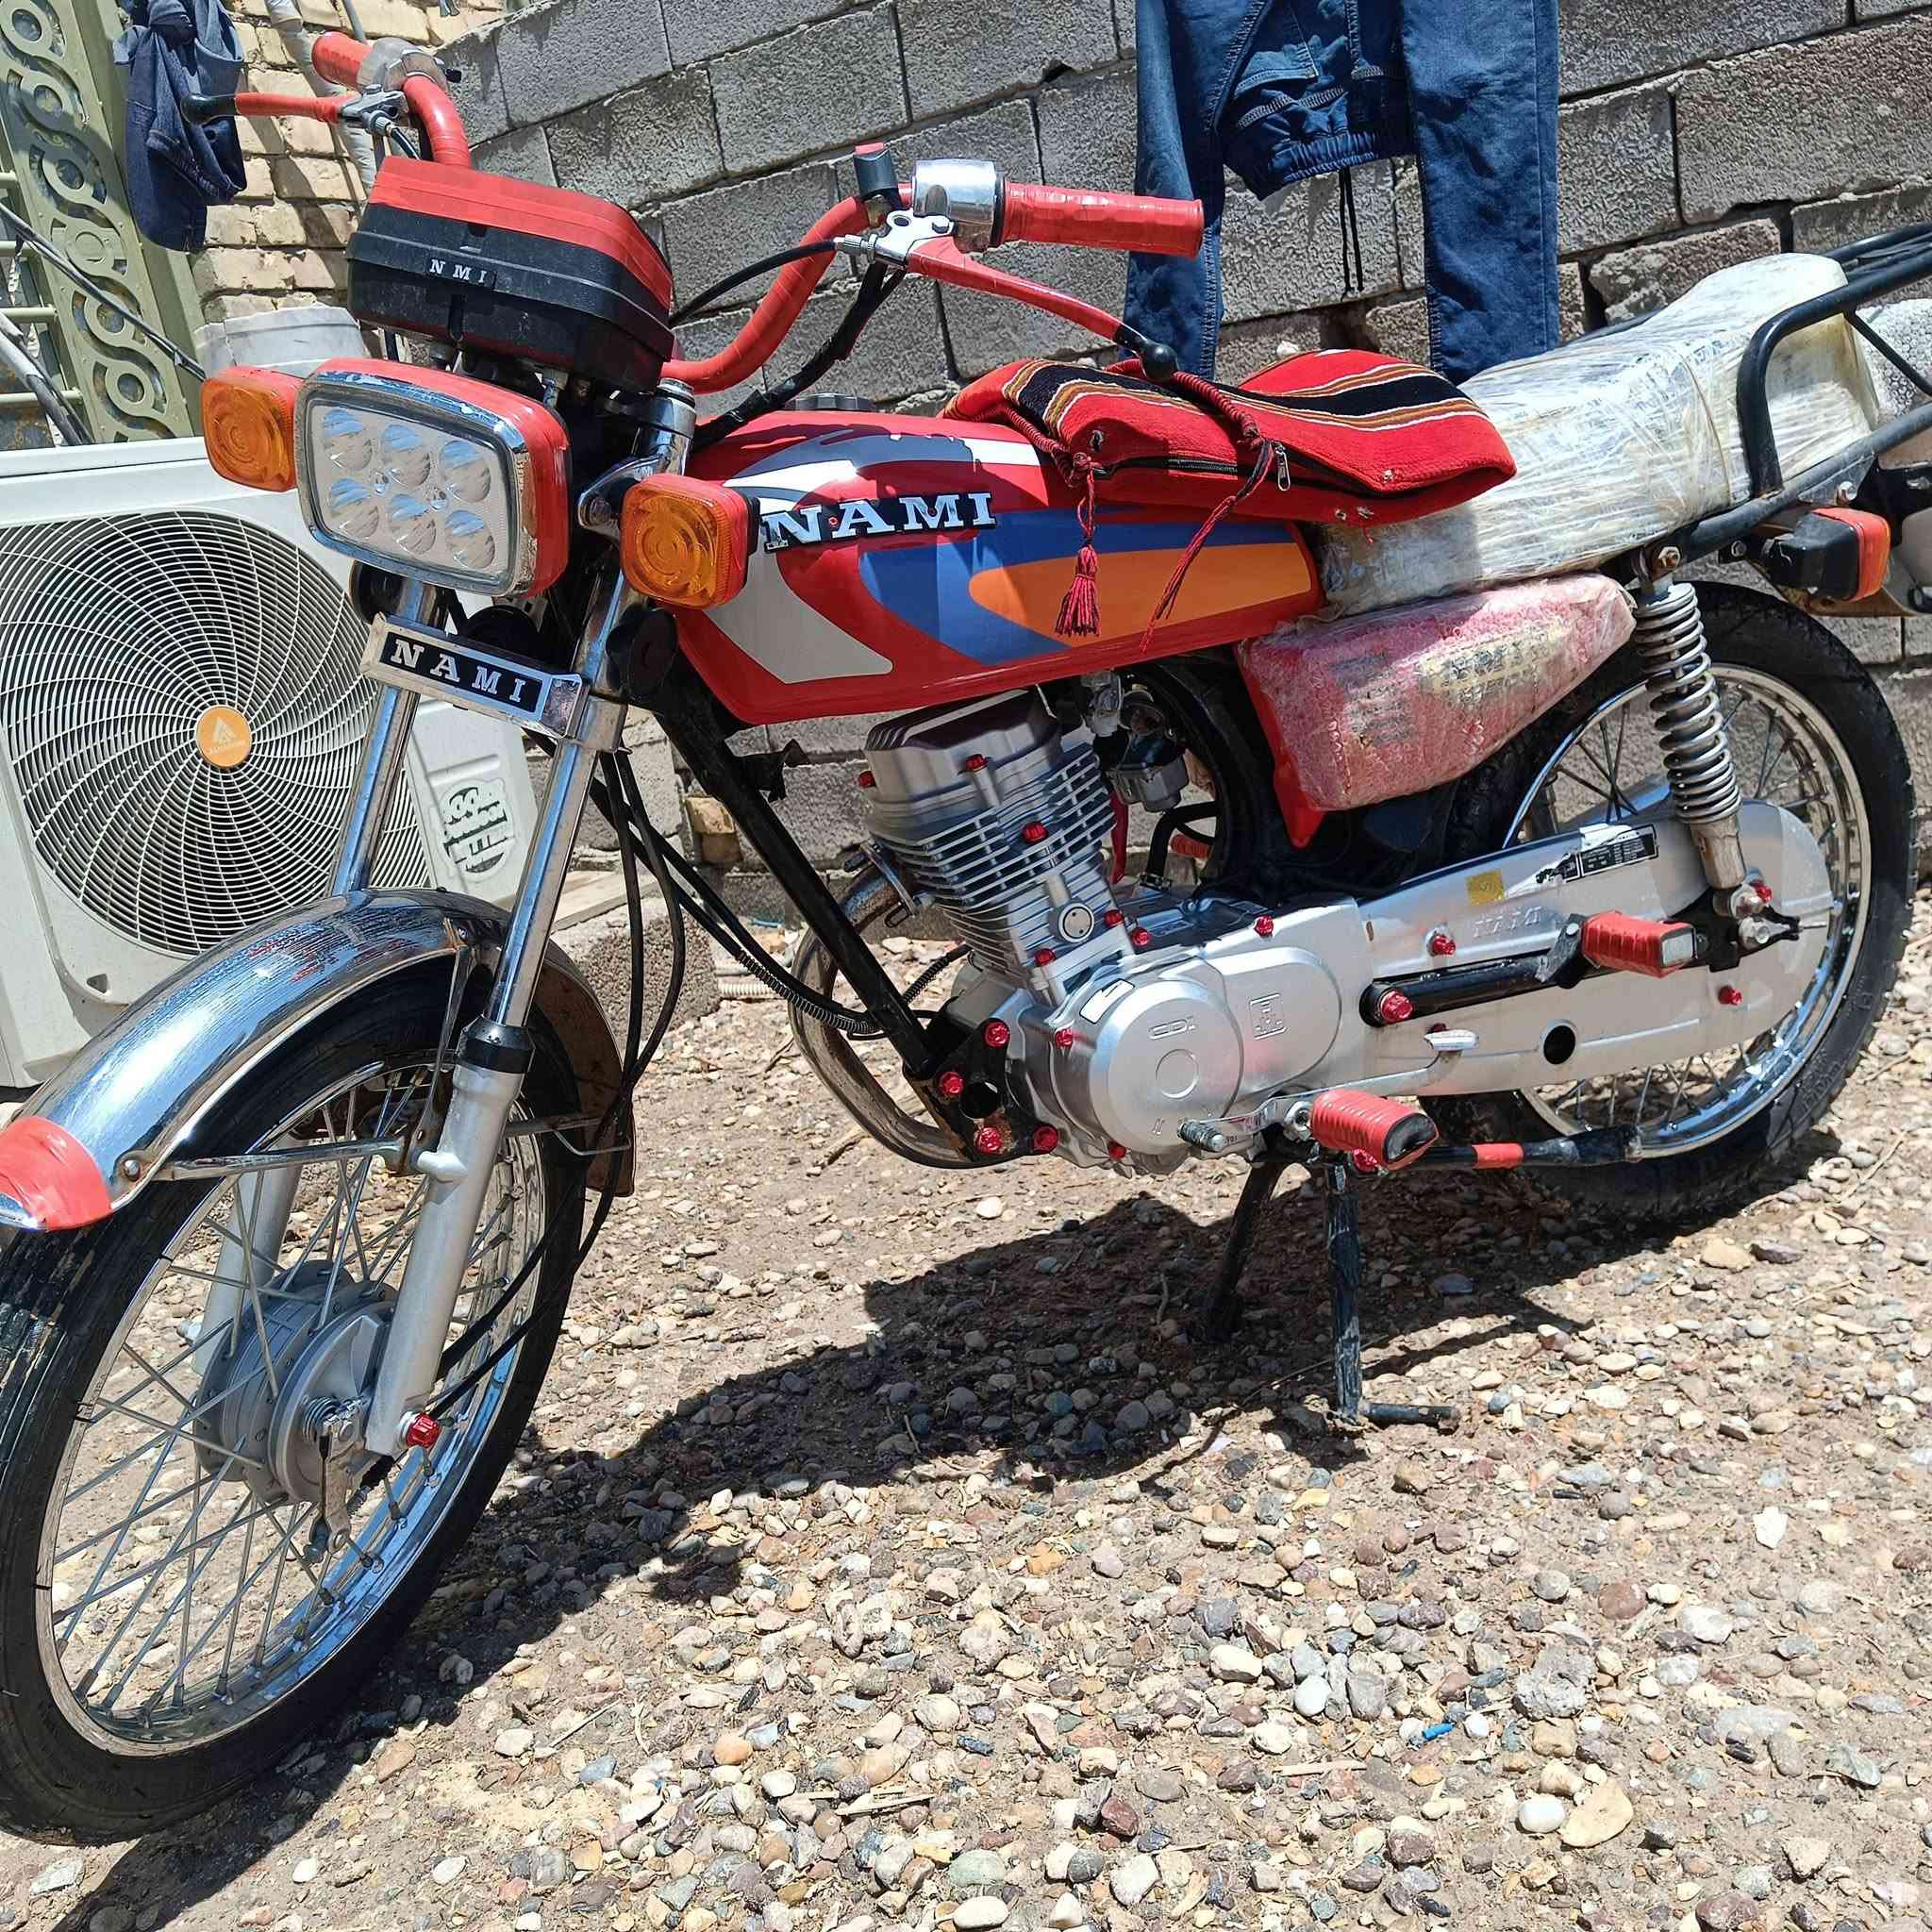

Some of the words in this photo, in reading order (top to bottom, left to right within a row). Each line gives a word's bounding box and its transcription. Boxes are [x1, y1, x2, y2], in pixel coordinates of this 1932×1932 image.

[429, 258, 487, 283] NMI
[761, 491, 996, 551] NAMI
[390, 638, 526, 703] NAMI
